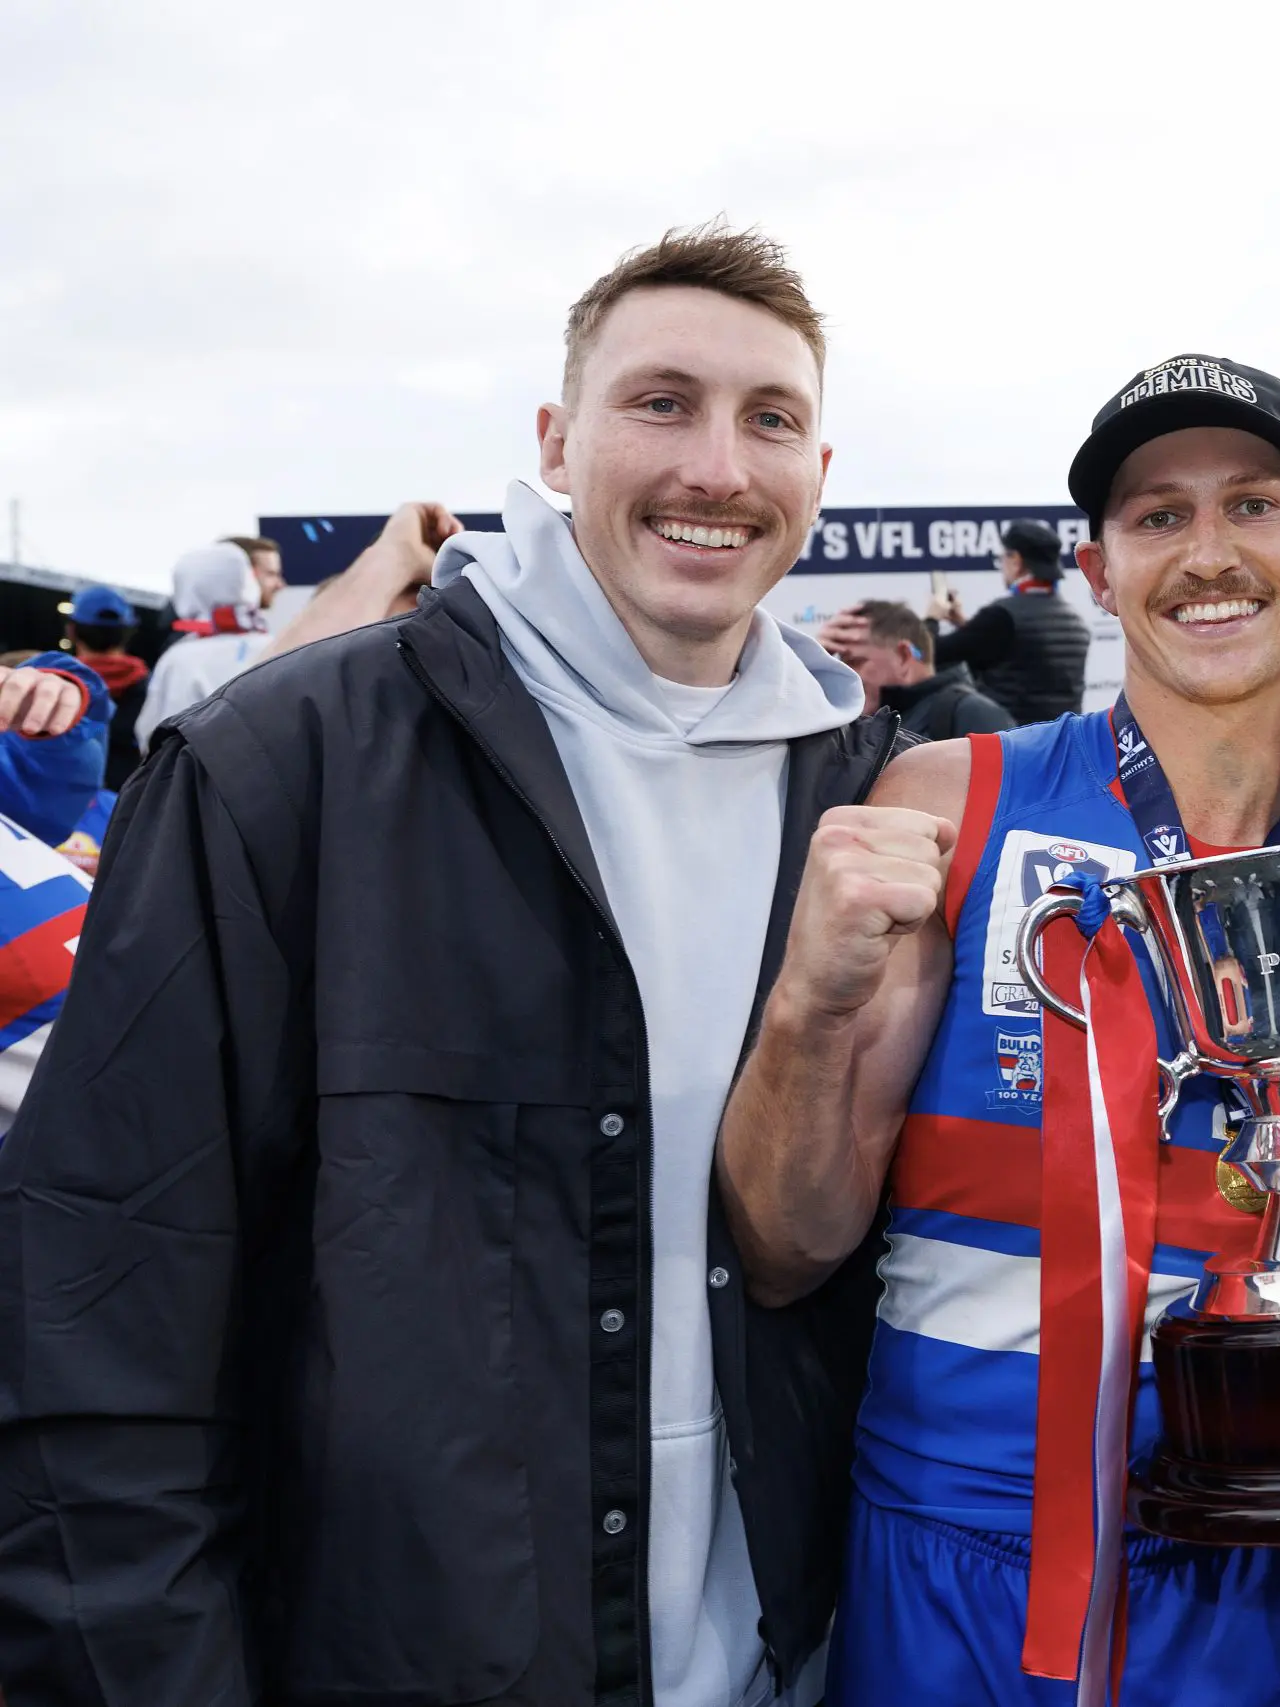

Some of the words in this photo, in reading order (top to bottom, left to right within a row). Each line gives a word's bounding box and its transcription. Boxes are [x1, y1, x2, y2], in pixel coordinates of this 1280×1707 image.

[853, 521, 924, 559] VFL
[1120, 755, 1155, 781] SMITHY'S
[1051, 845, 1086, 861] AFL
[998, 1091, 1018, 1099] 100
